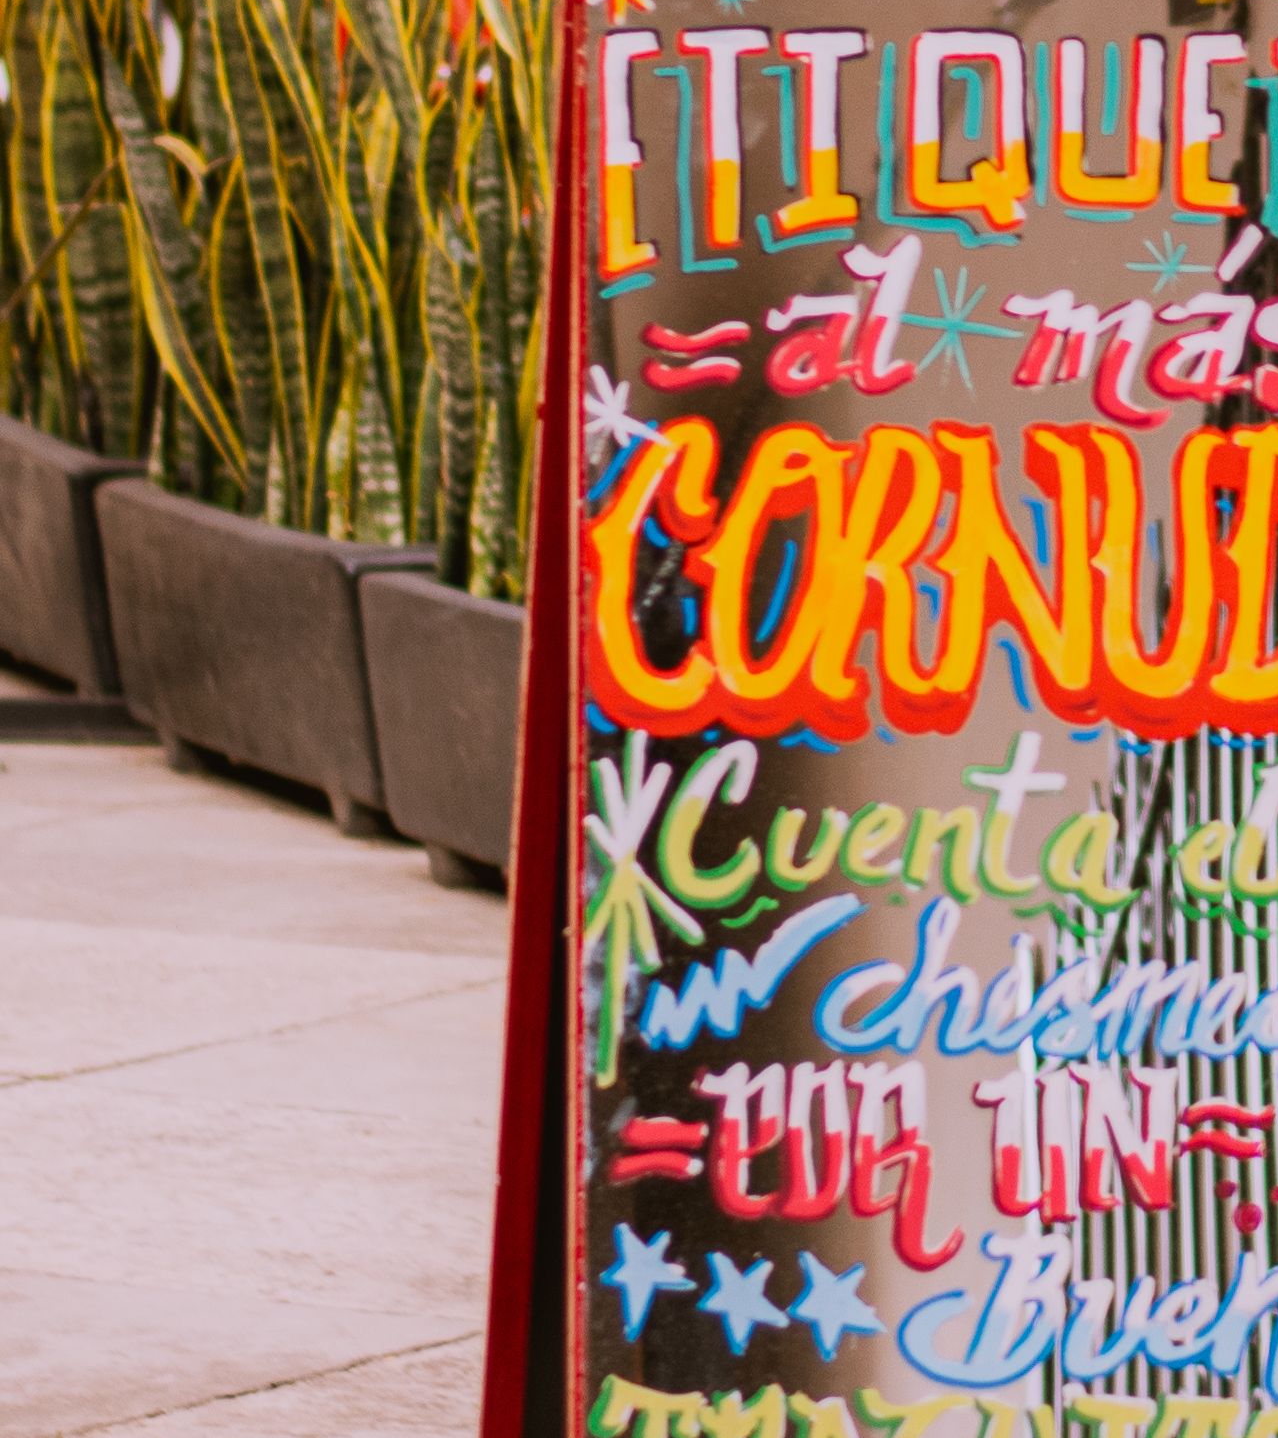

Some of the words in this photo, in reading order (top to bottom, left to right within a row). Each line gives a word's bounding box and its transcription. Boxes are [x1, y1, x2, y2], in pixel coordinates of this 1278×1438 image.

[765, 233, 922, 396] al
[657, 729, 1142, 913] Cuenta
[694, 1060, 964, 1272] POR
[973, 1058, 1180, 1225] UN
